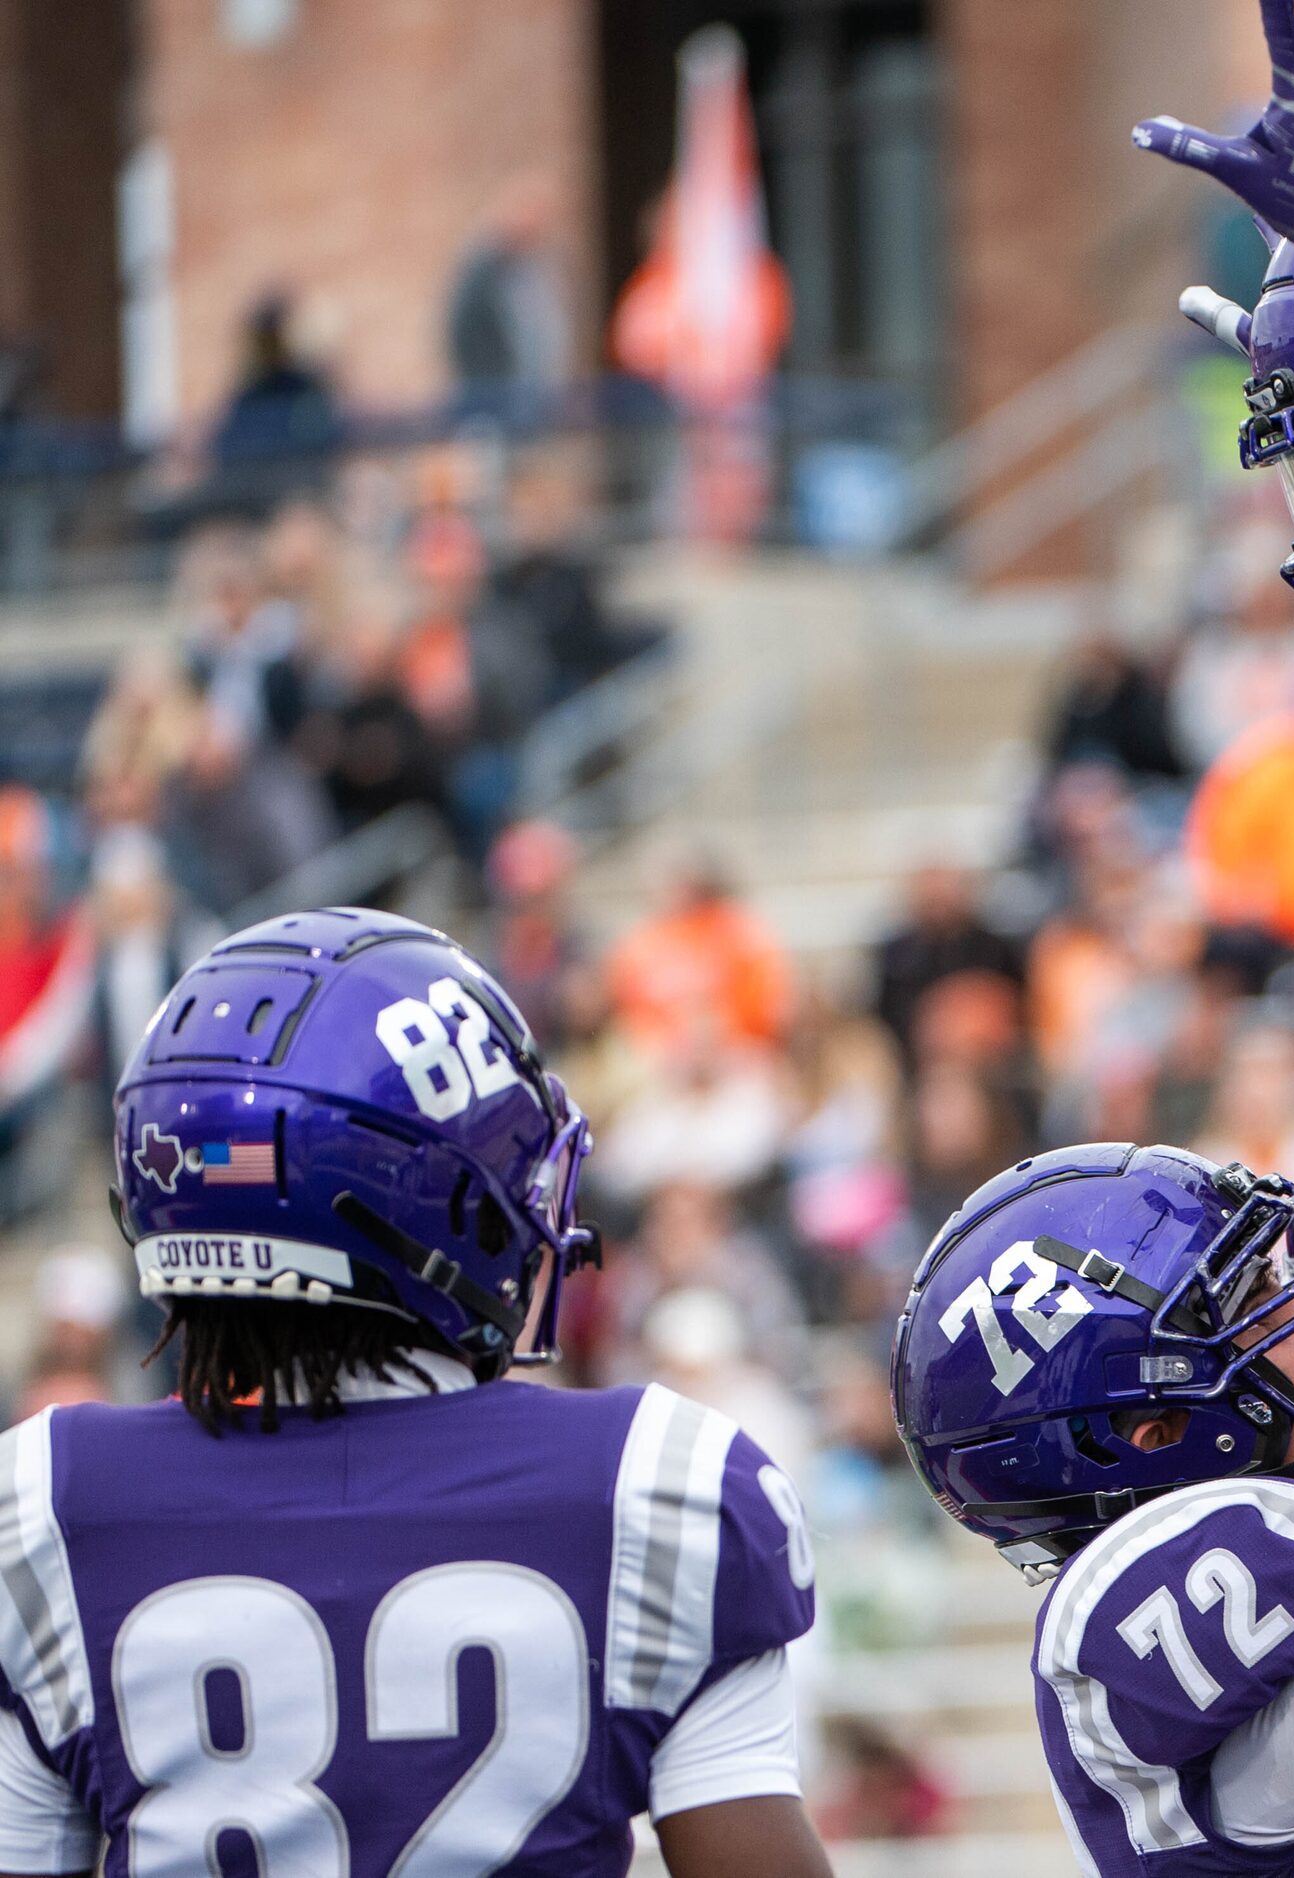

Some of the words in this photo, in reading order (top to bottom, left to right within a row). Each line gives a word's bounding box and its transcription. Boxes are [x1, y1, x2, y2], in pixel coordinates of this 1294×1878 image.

[375, 976, 520, 1124] 82
[157, 1238, 245, 1269] COYOTE
[254, 1242, 273, 1270] U
[937, 1240, 1096, 1397] 72
[110, 1559, 591, 1878] 82
